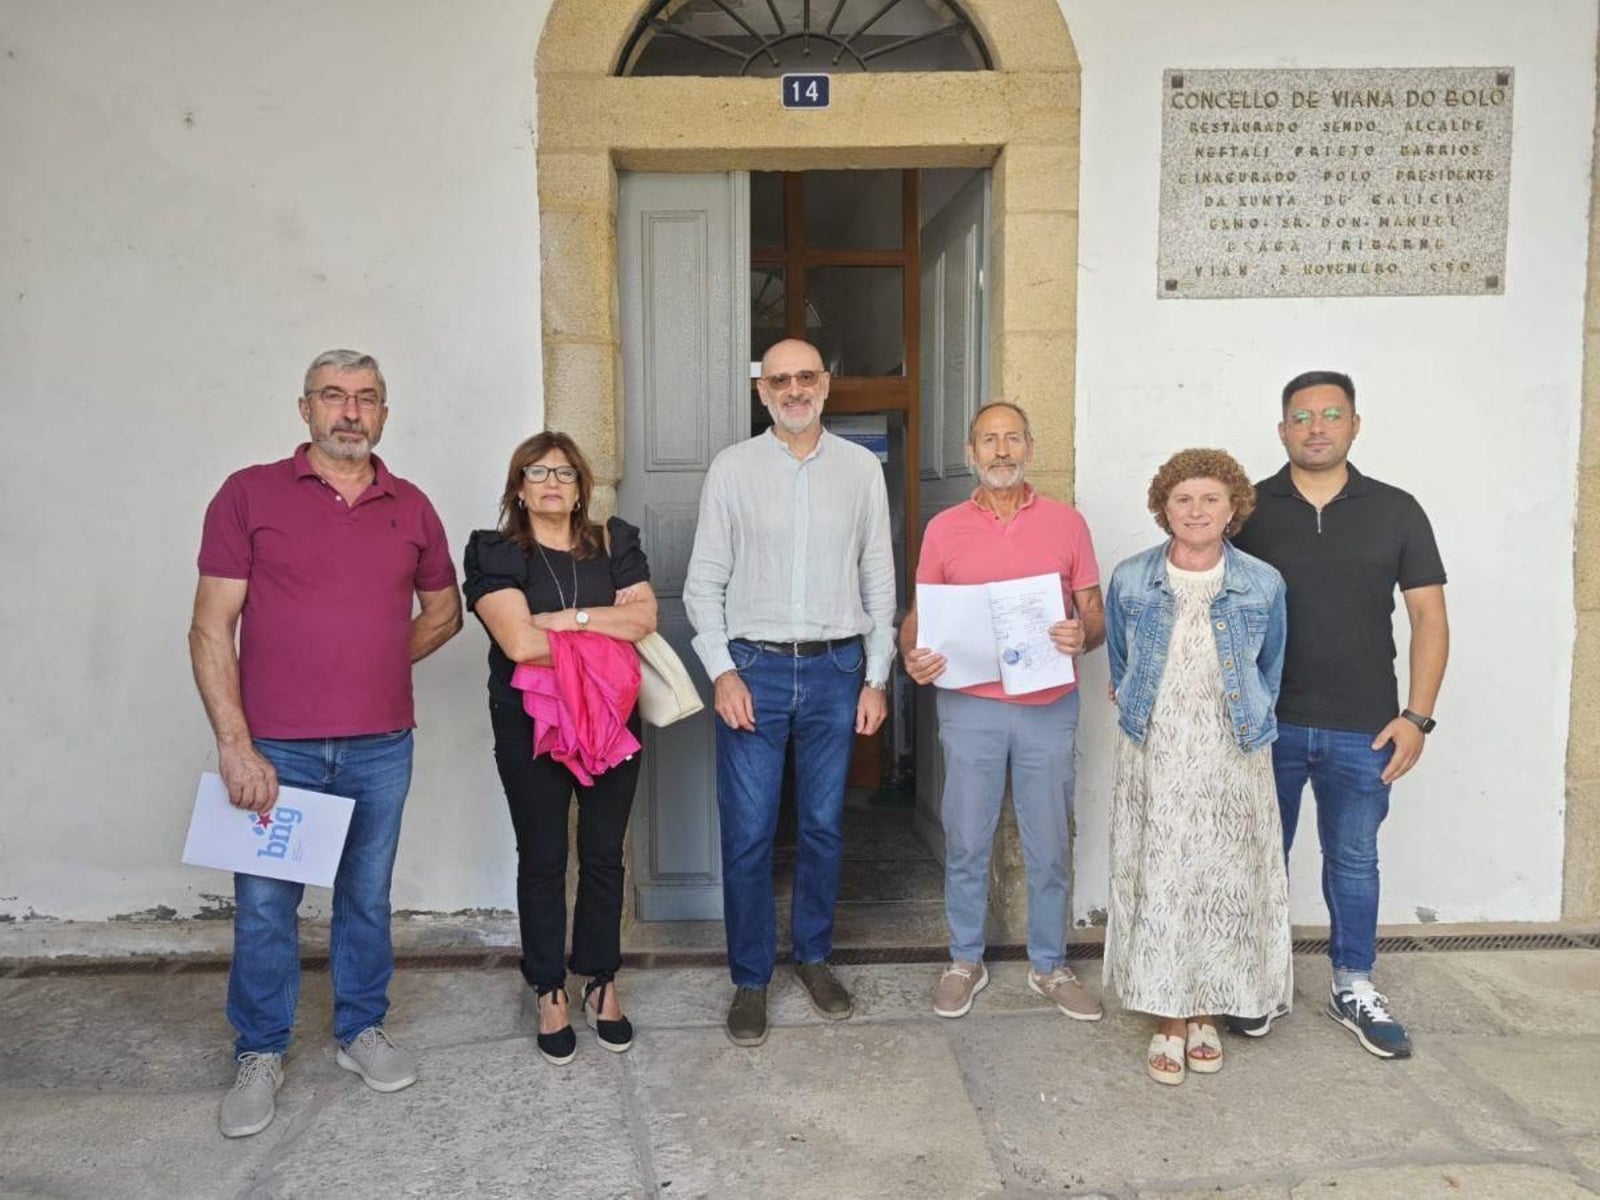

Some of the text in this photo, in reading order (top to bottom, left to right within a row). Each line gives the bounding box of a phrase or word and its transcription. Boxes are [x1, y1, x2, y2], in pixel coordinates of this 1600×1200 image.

[792, 80, 819, 102] 14
[1171, 89, 1505, 110] CONCELLO DE VIANA DO BOLO
[1189, 119, 1485, 134] RESTAURADO SENDO ALCALDE
[1294, 145, 1375, 158] PRIETO
[1400, 144, 1482, 157] BARRIOS
[1324, 170, 1371, 182] POLO
[1396, 169, 1496, 182] PRESIDENTE
[1204, 196, 1227, 208] DA
[1238, 195, 1297, 207] XUNTA
[1372, 192, 1464, 205] GALICIA
[1379, 215, 1459, 228] MANUEL
[257, 806, 303, 859] bng
